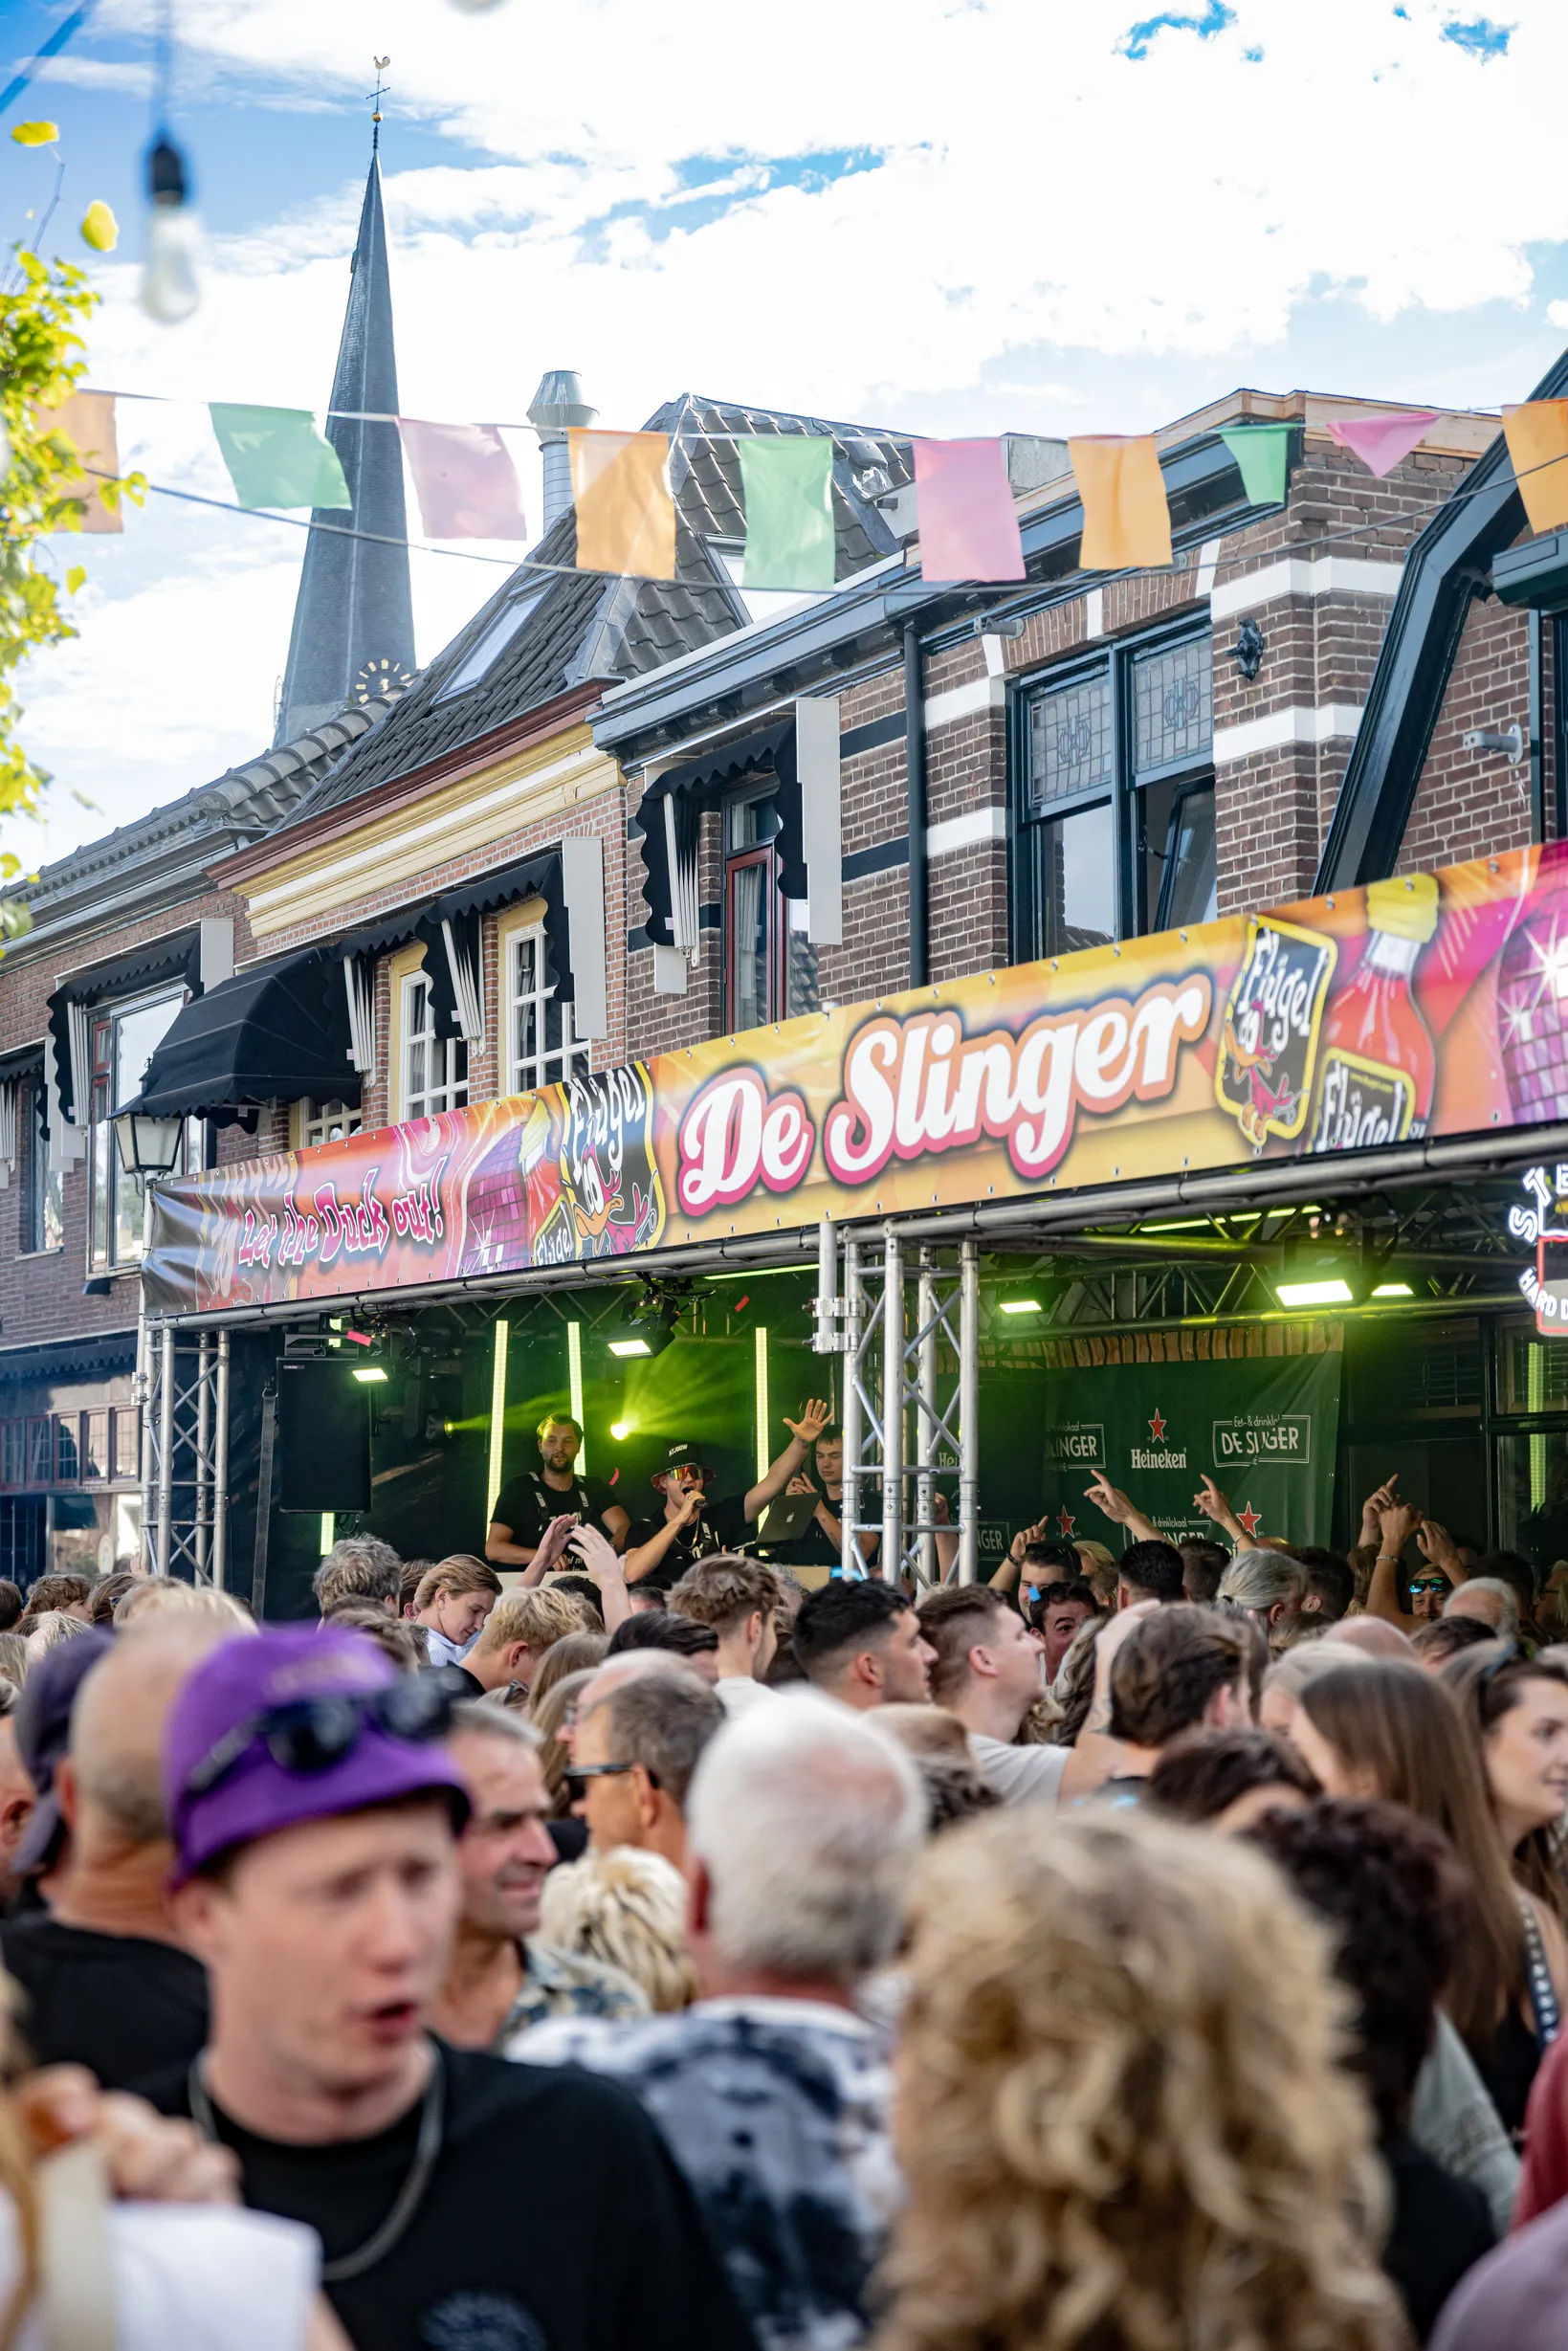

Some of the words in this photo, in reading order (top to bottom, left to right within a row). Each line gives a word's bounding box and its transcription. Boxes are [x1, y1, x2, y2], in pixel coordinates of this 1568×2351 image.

[1237, 925, 1328, 1054] Flügel
[568, 1064, 646, 1186] Flügel
[678, 1072, 812, 1209] De
[827, 983, 1207, 1178] Slinger
[238, 1209, 278, 1270] Let
[277, 1189, 320, 1267] the
[314, 1166, 390, 1255] Duck
[390, 1154, 449, 1245] out!
[1518, 1267, 1557, 1318] HARD
[1131, 1448, 1187, 1469] Heineken
[1221, 1432, 1244, 1455] DE
[1248, 1415, 1253, 1427] &
